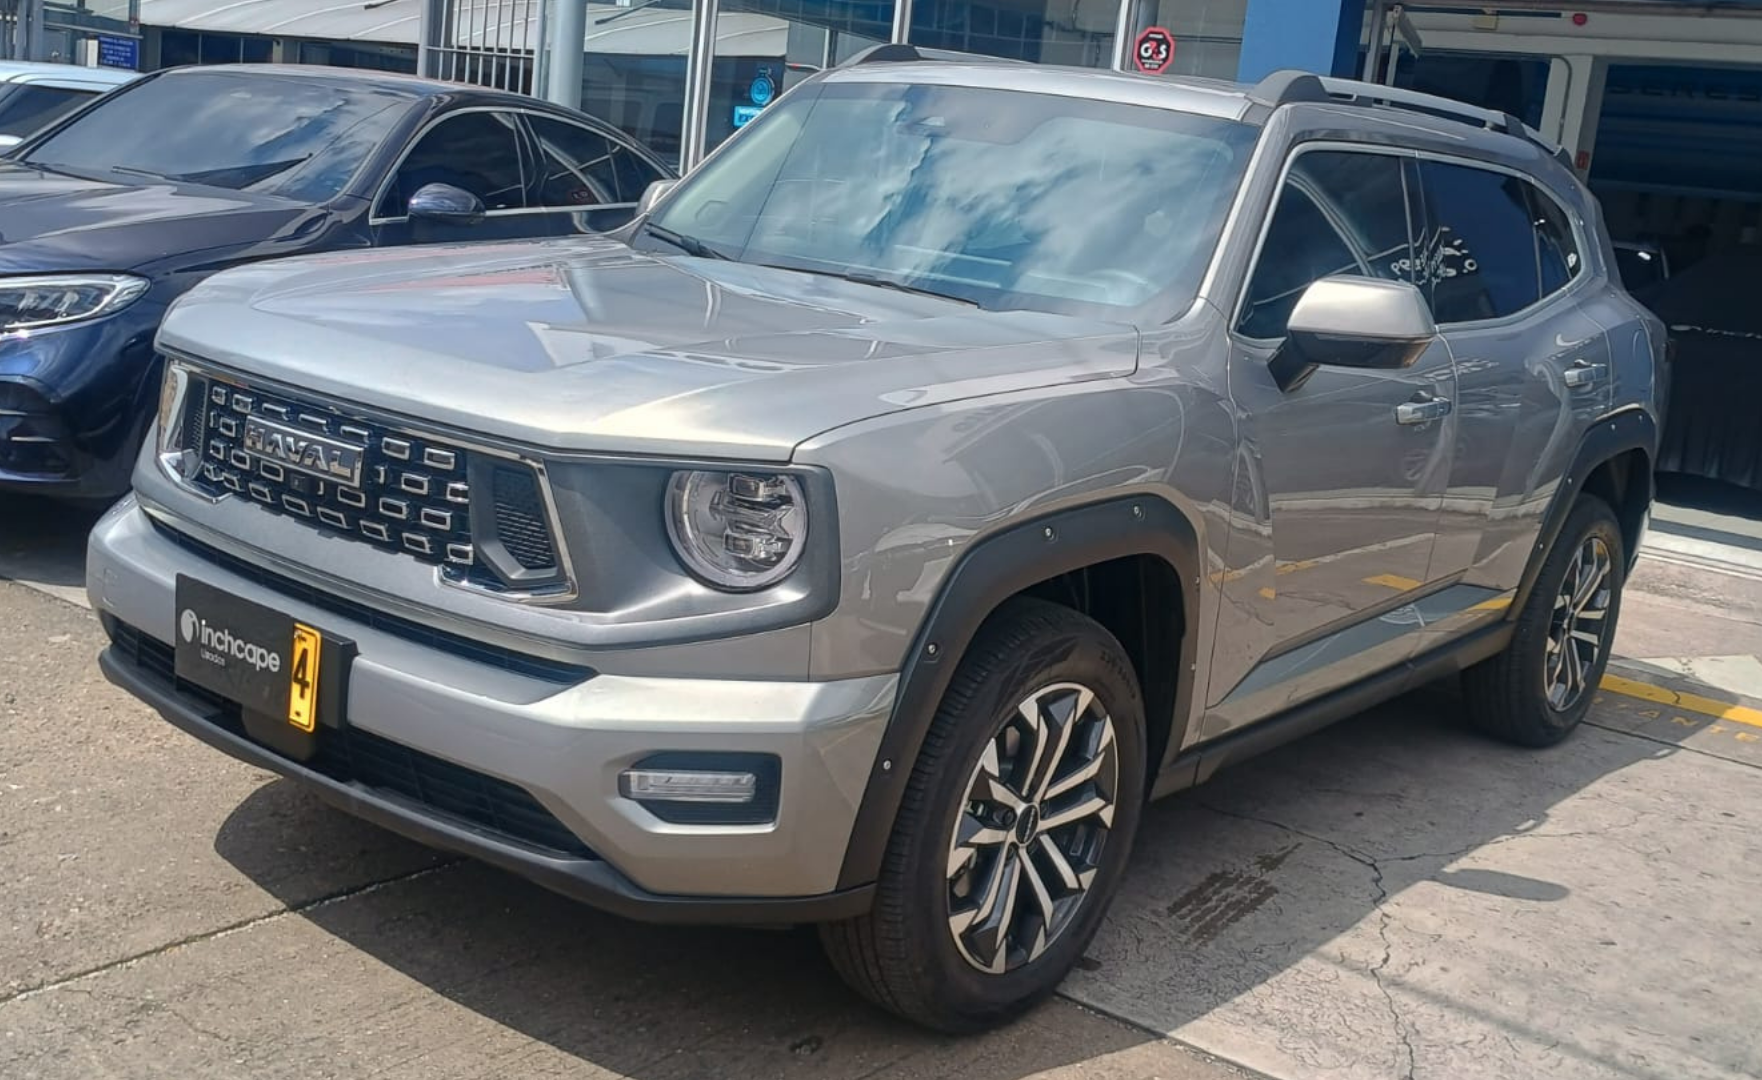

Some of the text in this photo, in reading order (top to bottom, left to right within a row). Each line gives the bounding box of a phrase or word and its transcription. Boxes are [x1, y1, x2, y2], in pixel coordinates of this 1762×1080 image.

[245, 425, 351, 478] HAVAL
[201, 619, 281, 673] inchcape
[293, 648, 311, 700] 4
